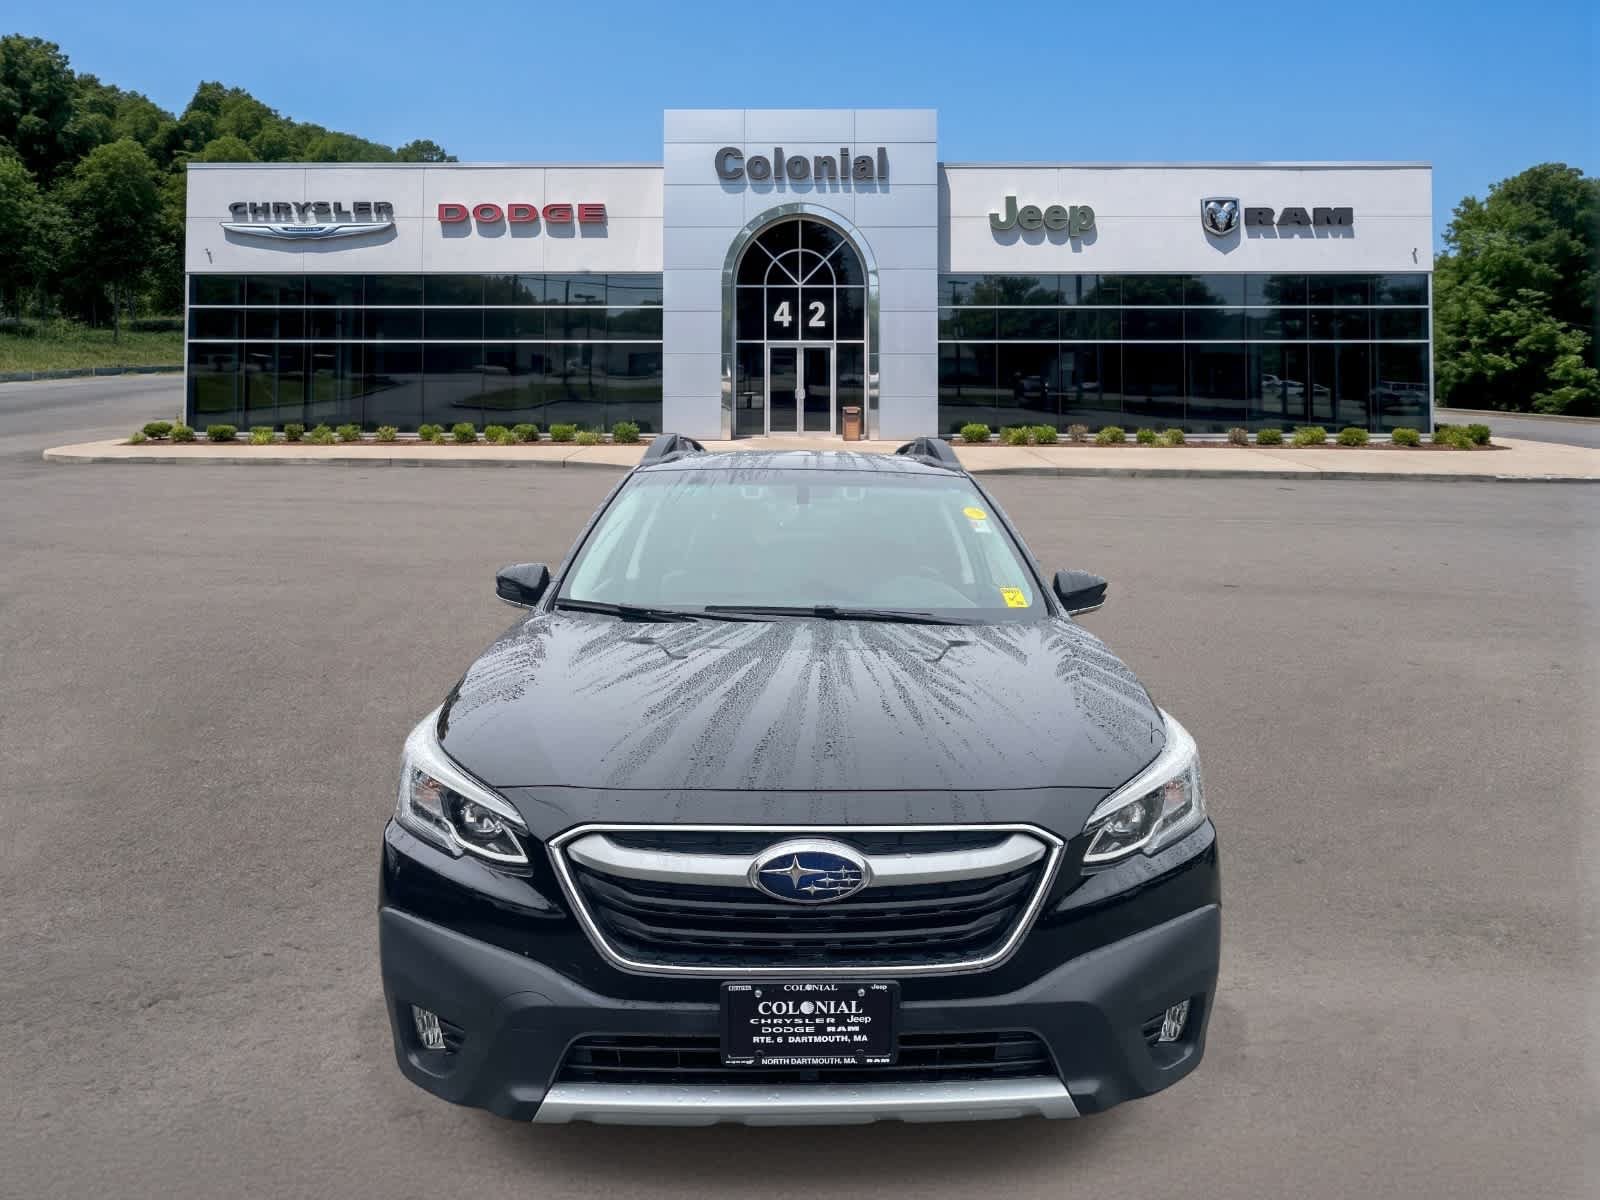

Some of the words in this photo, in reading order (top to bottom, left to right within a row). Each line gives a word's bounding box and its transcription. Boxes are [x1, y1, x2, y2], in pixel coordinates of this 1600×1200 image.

[714, 146, 889, 181] Colonial
[228, 201, 395, 216] CHRYSLER
[438, 203, 607, 223] DODGE
[988, 196, 1095, 237] Jeep
[1244, 206, 1354, 227] RAM
[783, 984, 838, 992] COLONIAL
[757, 1000, 863, 1015] COLONIAL
[847, 1015, 872, 1024] Jeep
[752, 1036, 775, 1044] RTE.
[776, 1036, 783, 1044] 6
[788, 1034, 851, 1044] DARTMOUTH,
[853, 1034, 868, 1042] MA
